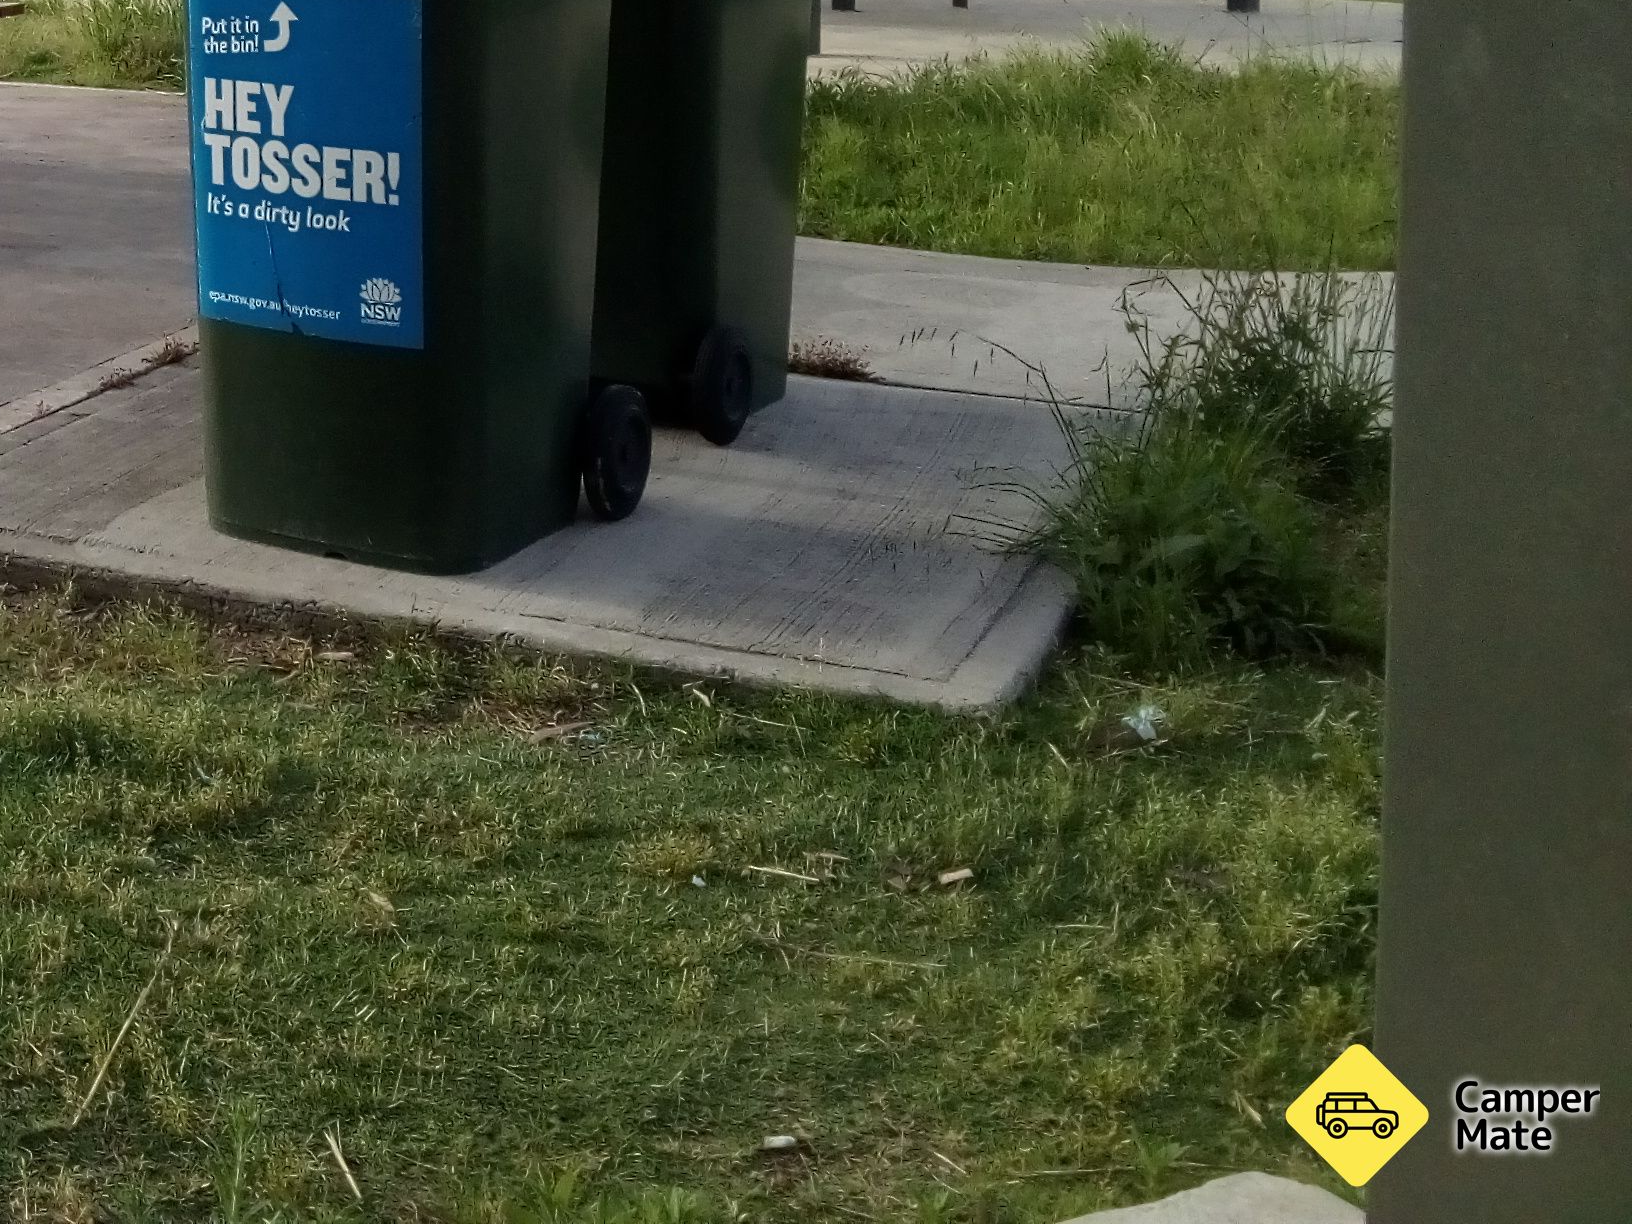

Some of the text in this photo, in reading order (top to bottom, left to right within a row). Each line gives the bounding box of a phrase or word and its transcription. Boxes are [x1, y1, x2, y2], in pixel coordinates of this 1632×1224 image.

[202, 16, 259, 35] Put it in
[204, 35, 259, 54] the bin!
[204, 77, 294, 137] HEY
[204, 133, 400, 206] TOSSER!
[207, 193, 351, 232] It's a dirty look
[360, 303, 401, 321] NSW
